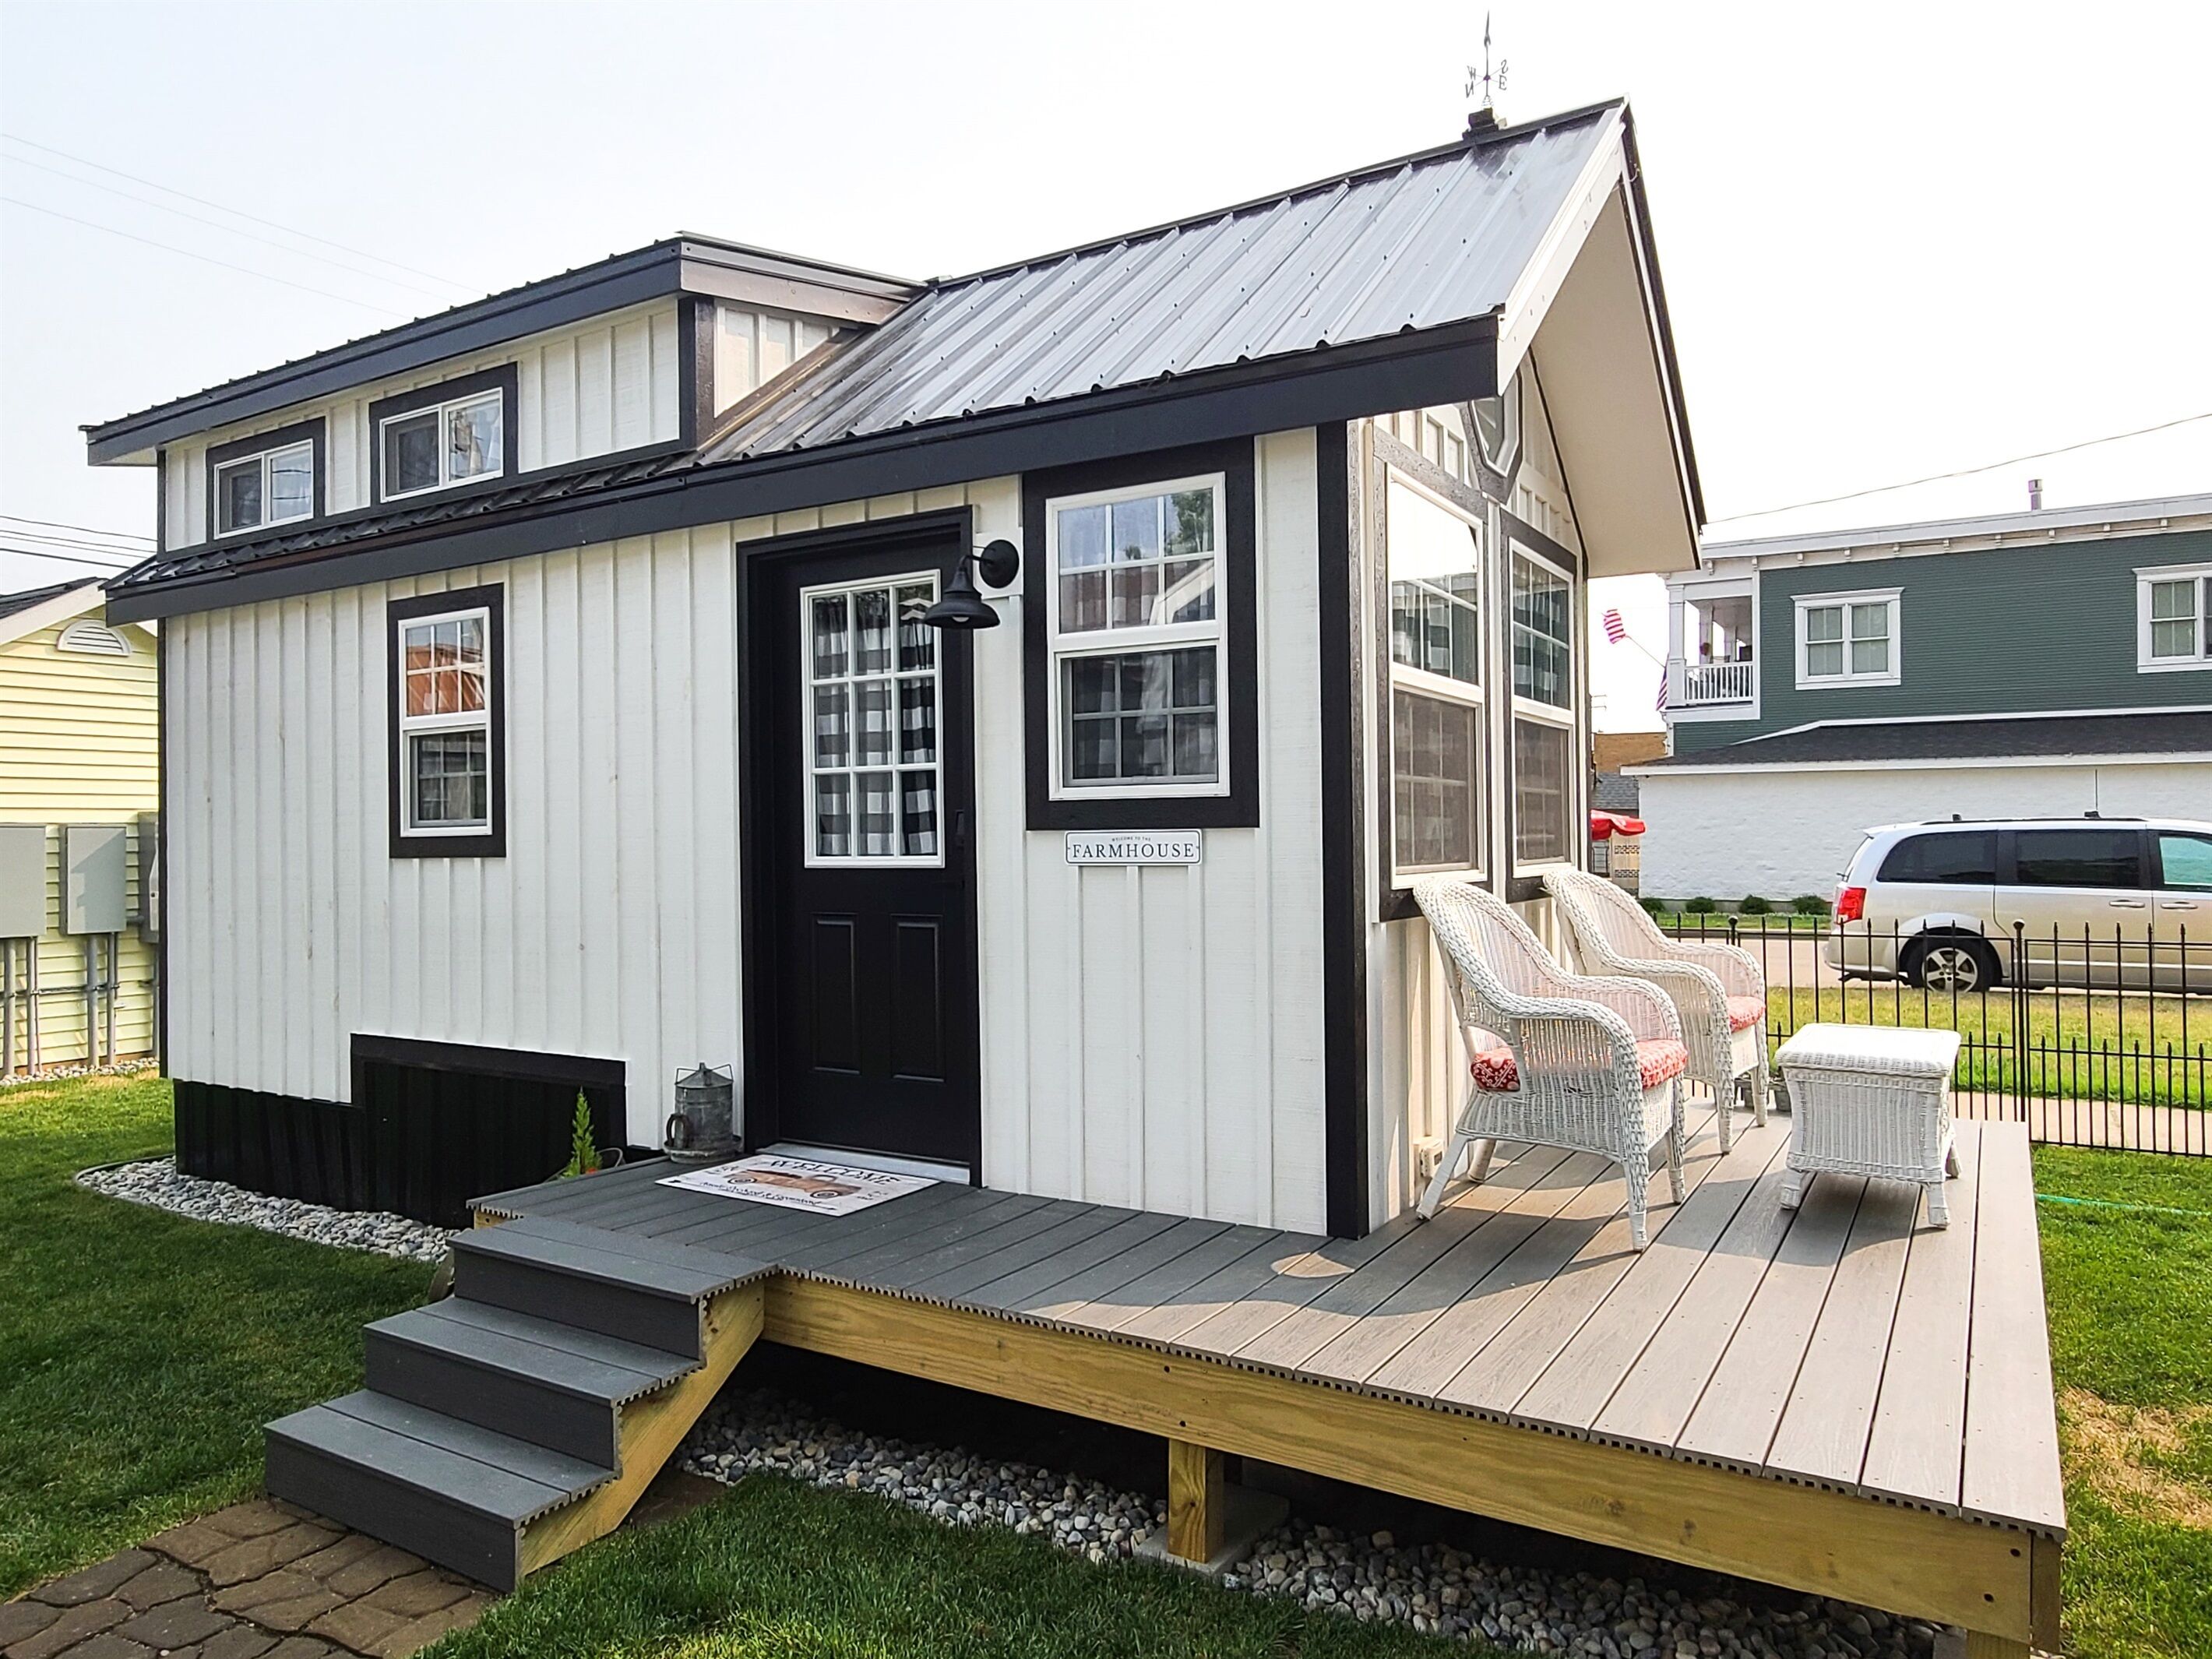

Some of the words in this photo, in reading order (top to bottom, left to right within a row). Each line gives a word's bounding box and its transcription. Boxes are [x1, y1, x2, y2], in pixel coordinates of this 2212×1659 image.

[1467, 65, 1477, 81] W
[1499, 74, 1507, 91] E
[1072, 843, 1194, 858] FARMHOUSE
[770, 1160, 901, 1185] WELCOME
